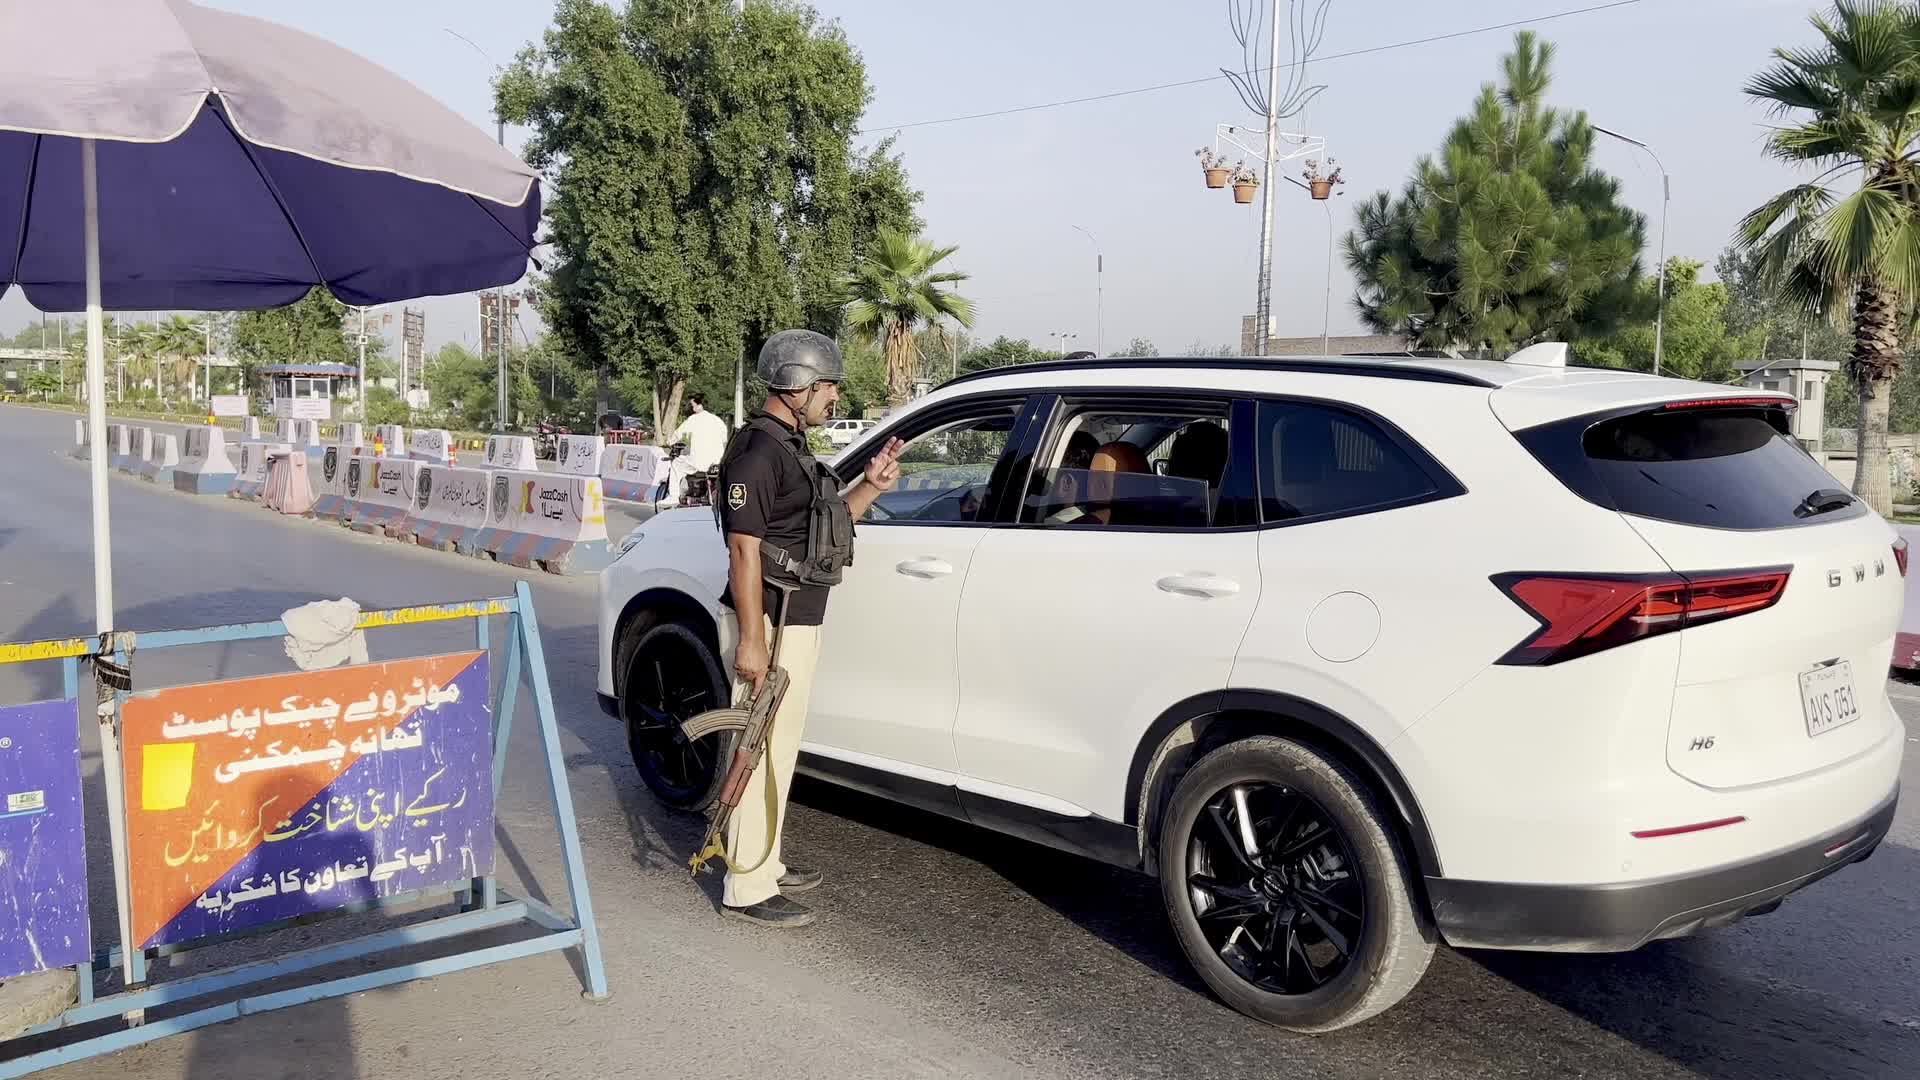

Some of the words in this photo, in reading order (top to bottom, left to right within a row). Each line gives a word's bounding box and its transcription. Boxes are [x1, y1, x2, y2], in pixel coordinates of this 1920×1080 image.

[538, 487, 569, 503] JazzCash
[163, 706, 261, 740] پوسٹ
[264, 695, 340, 728] چیک
[1810, 693, 1833, 728] AYS
[1834, 685, 1857, 719] 051
[350, 721, 422, 755] تھانہ
[1690, 736, 1715, 750] H6
[214, 737, 346, 784] چمکنی
[263, 793, 356, 842] شناخت
[356, 788, 400, 831] اپنی
[164, 794, 279, 866] کروائیں
[369, 847, 408, 882] کے
[409, 833, 447, 873] آپ
[196, 871, 277, 914] شکریہ
[279, 867, 301, 894] کا
[304, 855, 369, 894] تعاون
